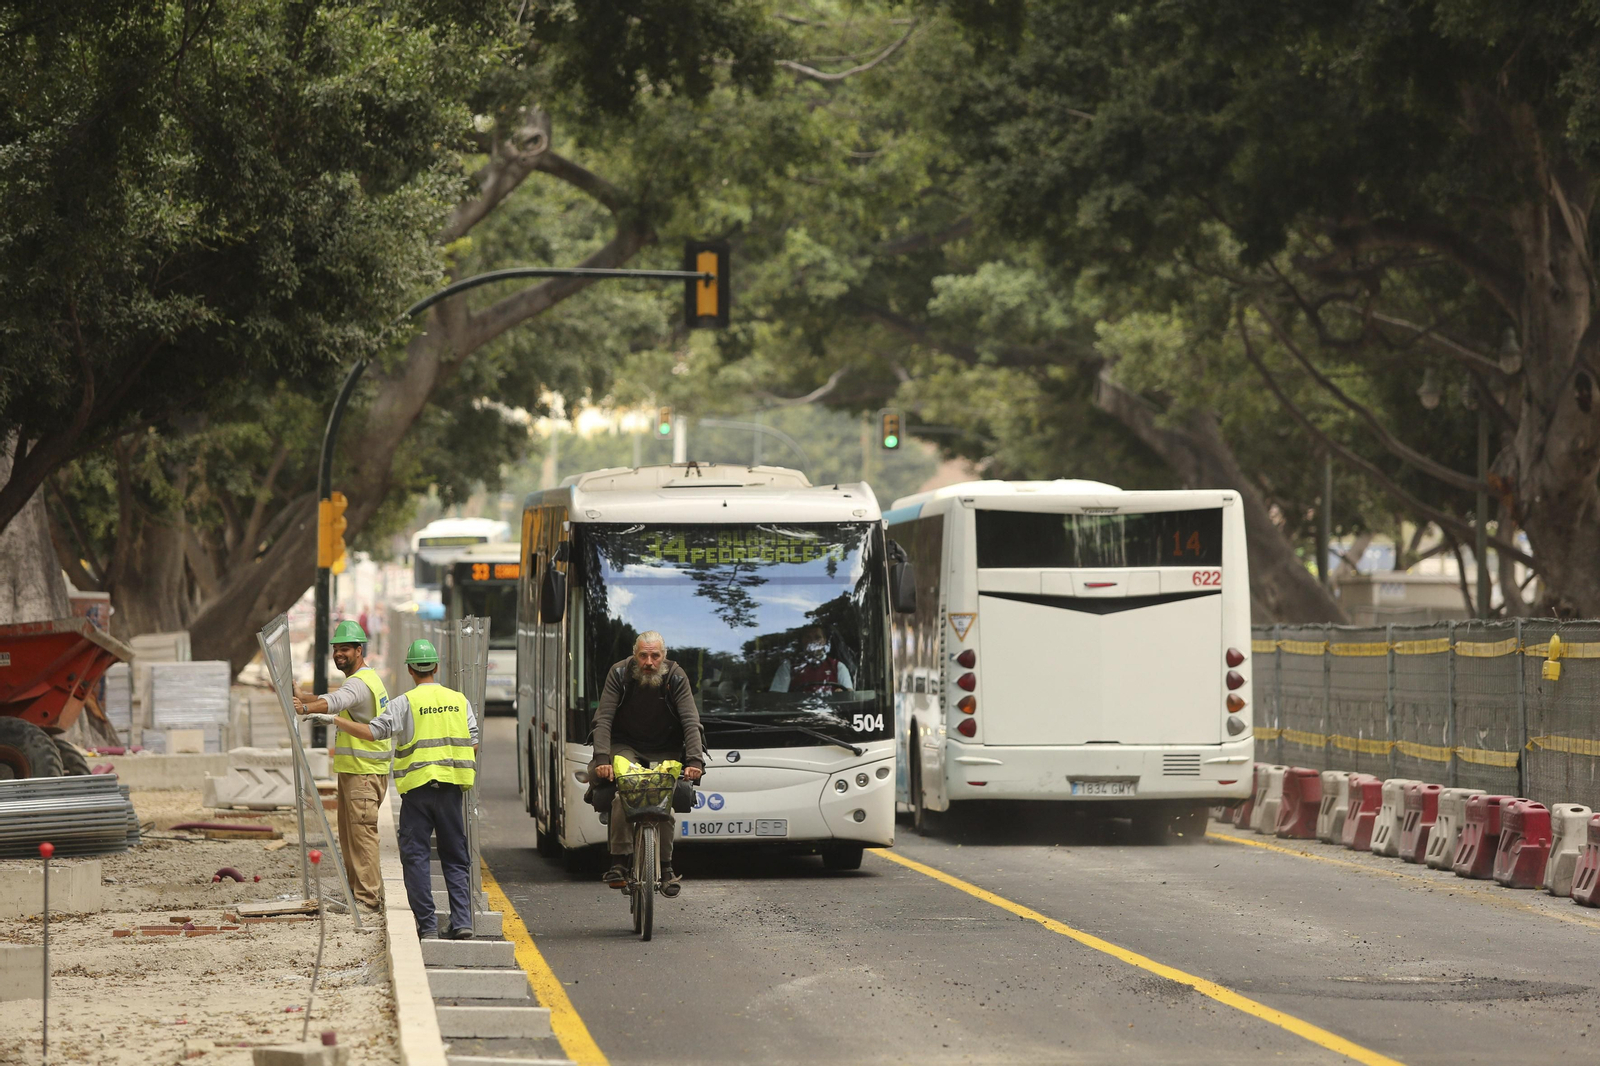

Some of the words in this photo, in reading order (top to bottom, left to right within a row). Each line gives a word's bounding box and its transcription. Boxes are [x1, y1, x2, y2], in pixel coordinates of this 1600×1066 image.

[1172, 530, 1201, 557] 14
[1192, 570, 1221, 586] 622
[419, 705, 460, 715] fatecres
[852, 713, 884, 732] 504
[1081, 783, 1107, 795] 1834
[692, 822, 723, 835] 1807
[727, 821, 752, 834] CTJ
